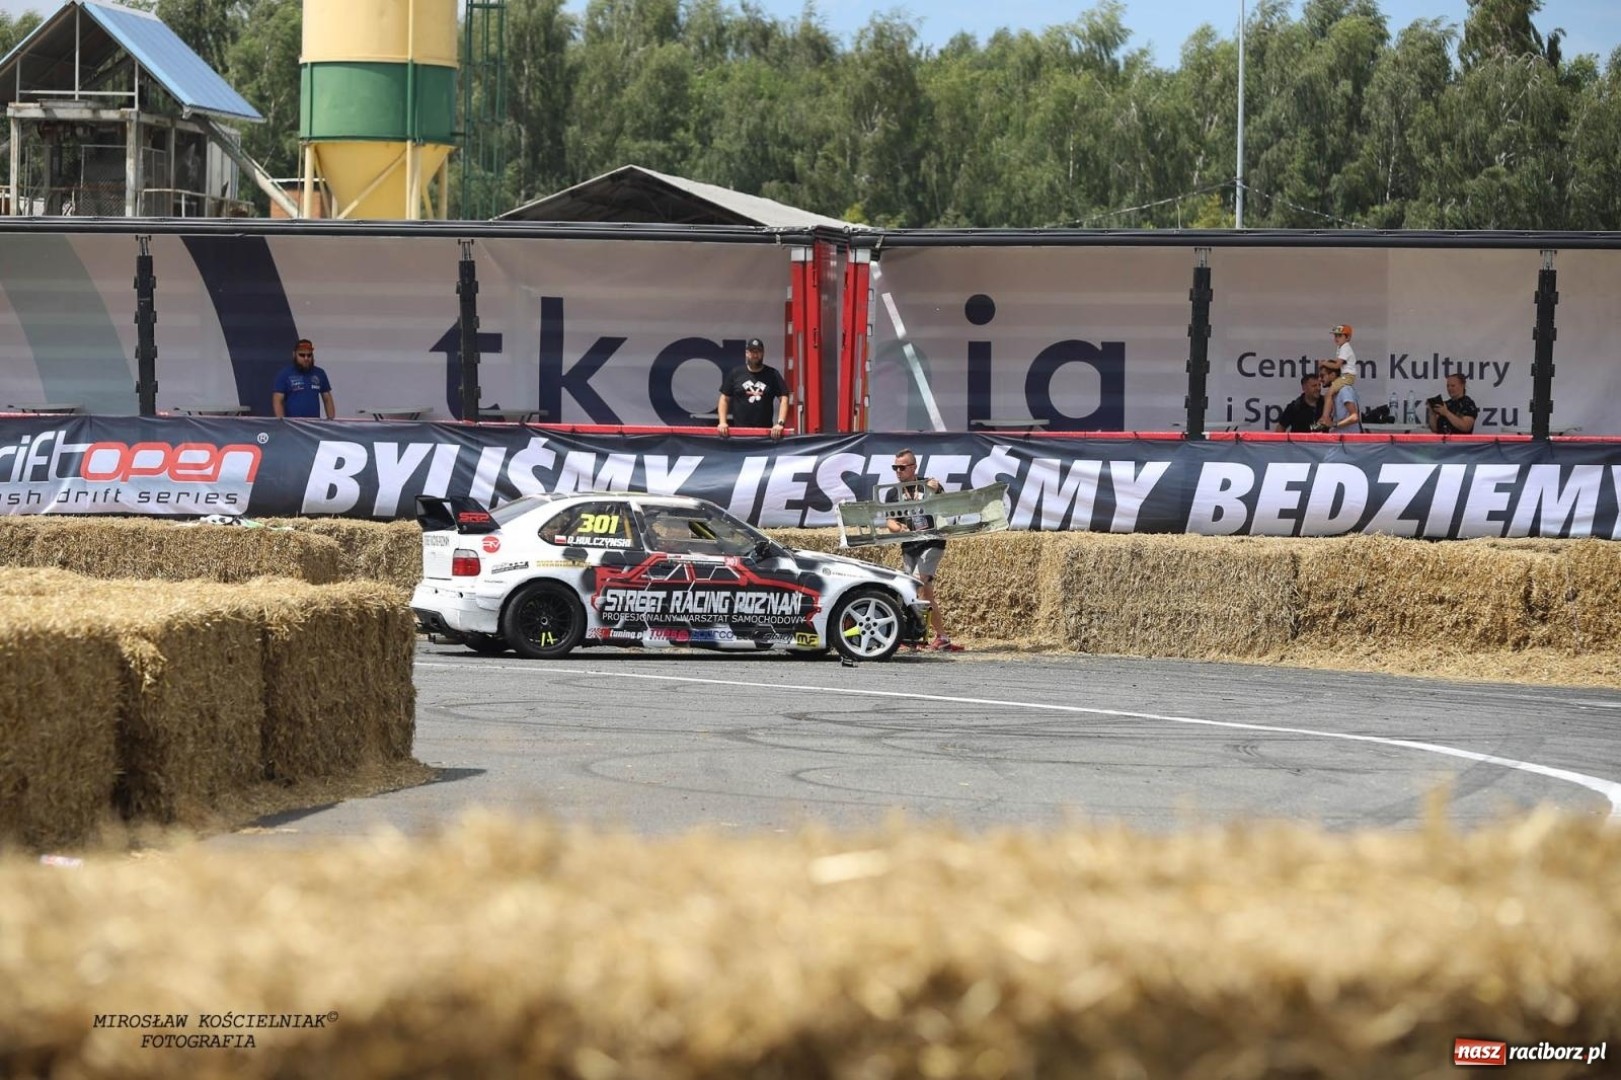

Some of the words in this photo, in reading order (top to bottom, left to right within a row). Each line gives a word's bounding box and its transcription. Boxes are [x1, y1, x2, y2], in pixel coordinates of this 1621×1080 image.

[1390, 353, 1511, 387] Kultury
[1226, 397, 1233, 422] i
[57, 488, 121, 503] drift
[138, 491, 238, 504] series
[577, 514, 619, 534] 301
[604, 589, 667, 613] STREET
[670, 590, 731, 614] RACING
[602, 611, 679, 623] PROFESJONALNY
[680, 613, 730, 623] WARSZTAT
[731, 614, 806, 625] SAMOCHODOWY
